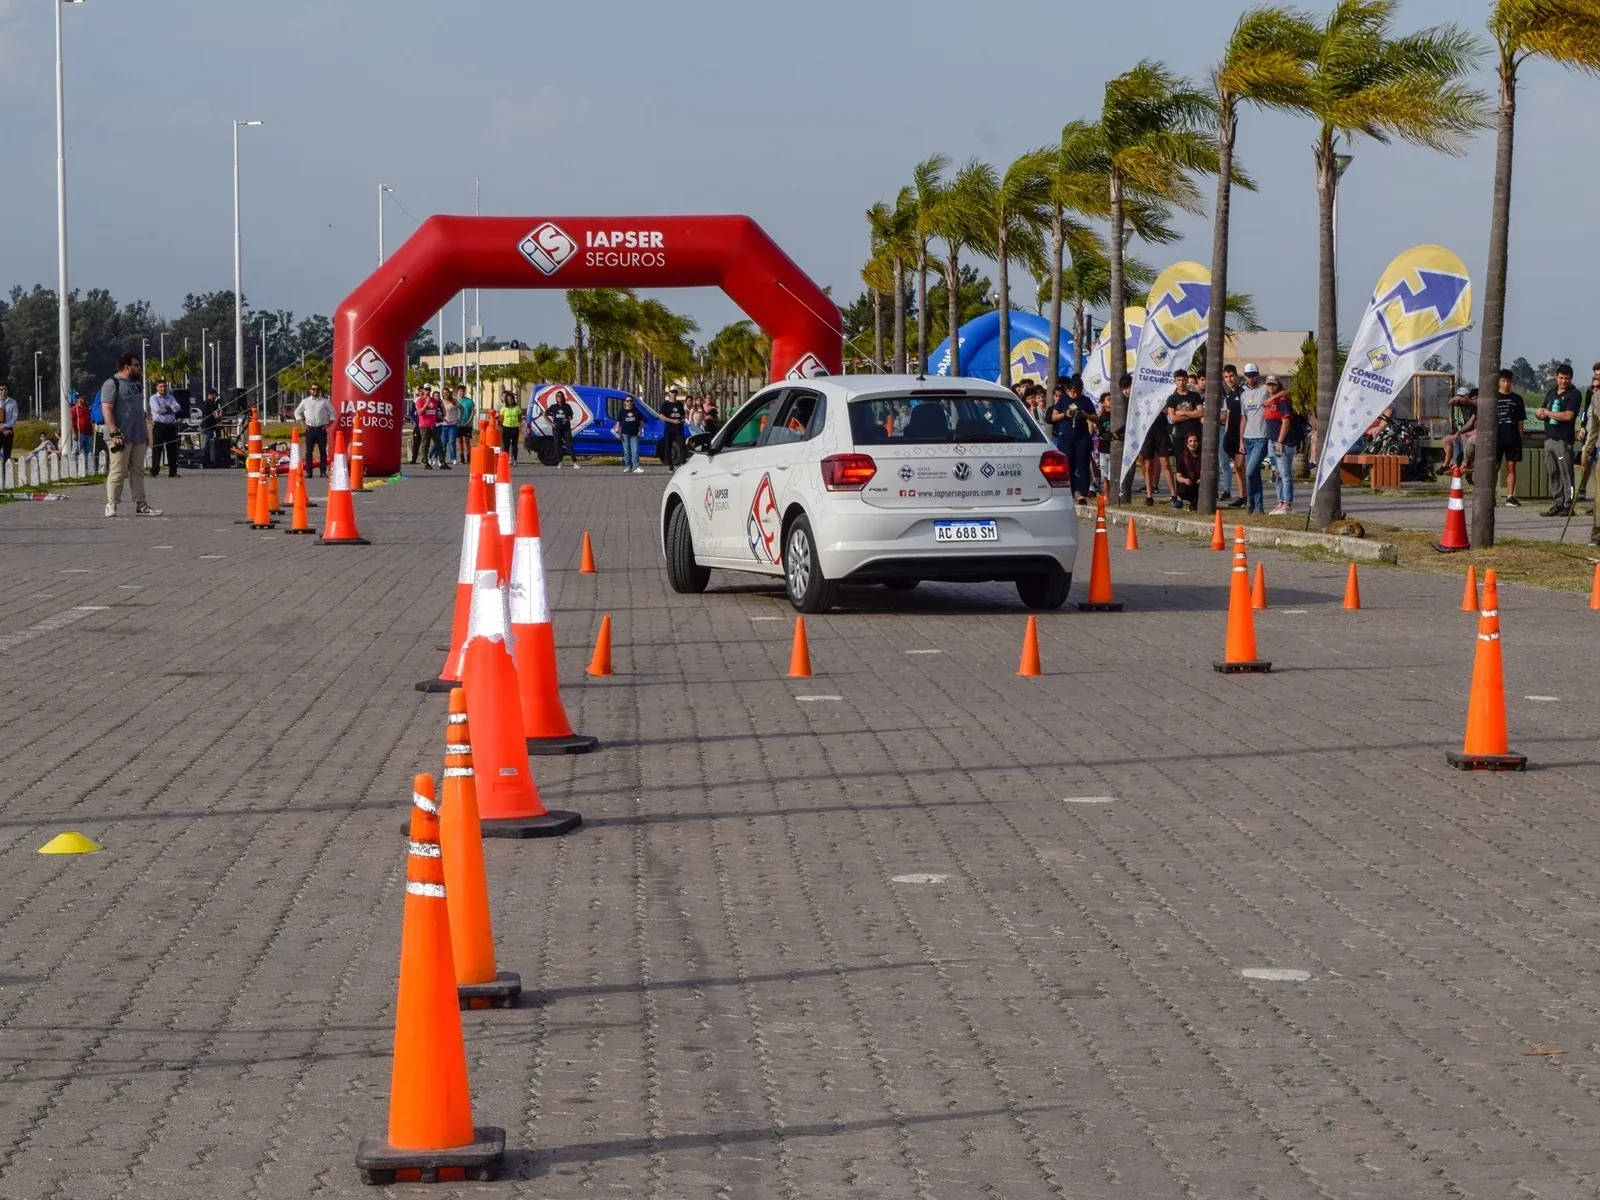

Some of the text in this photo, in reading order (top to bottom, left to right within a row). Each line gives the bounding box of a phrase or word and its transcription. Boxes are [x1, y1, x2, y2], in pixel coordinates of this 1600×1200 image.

[586, 231, 665, 248] IAPSER
[585, 252, 666, 267] SEGUROS
[1140, 367, 1174, 378] CONDUC
[1149, 376, 1175, 385] CURSO
[1348, 374, 1393, 395] TU CURSO
[340, 400, 394, 416] IAPSER
[715, 489, 729, 499] IAPSER
[917, 488, 1002, 500] www.iapserseguros.com.ar
[938, 526, 995, 540] AC 688 SM
